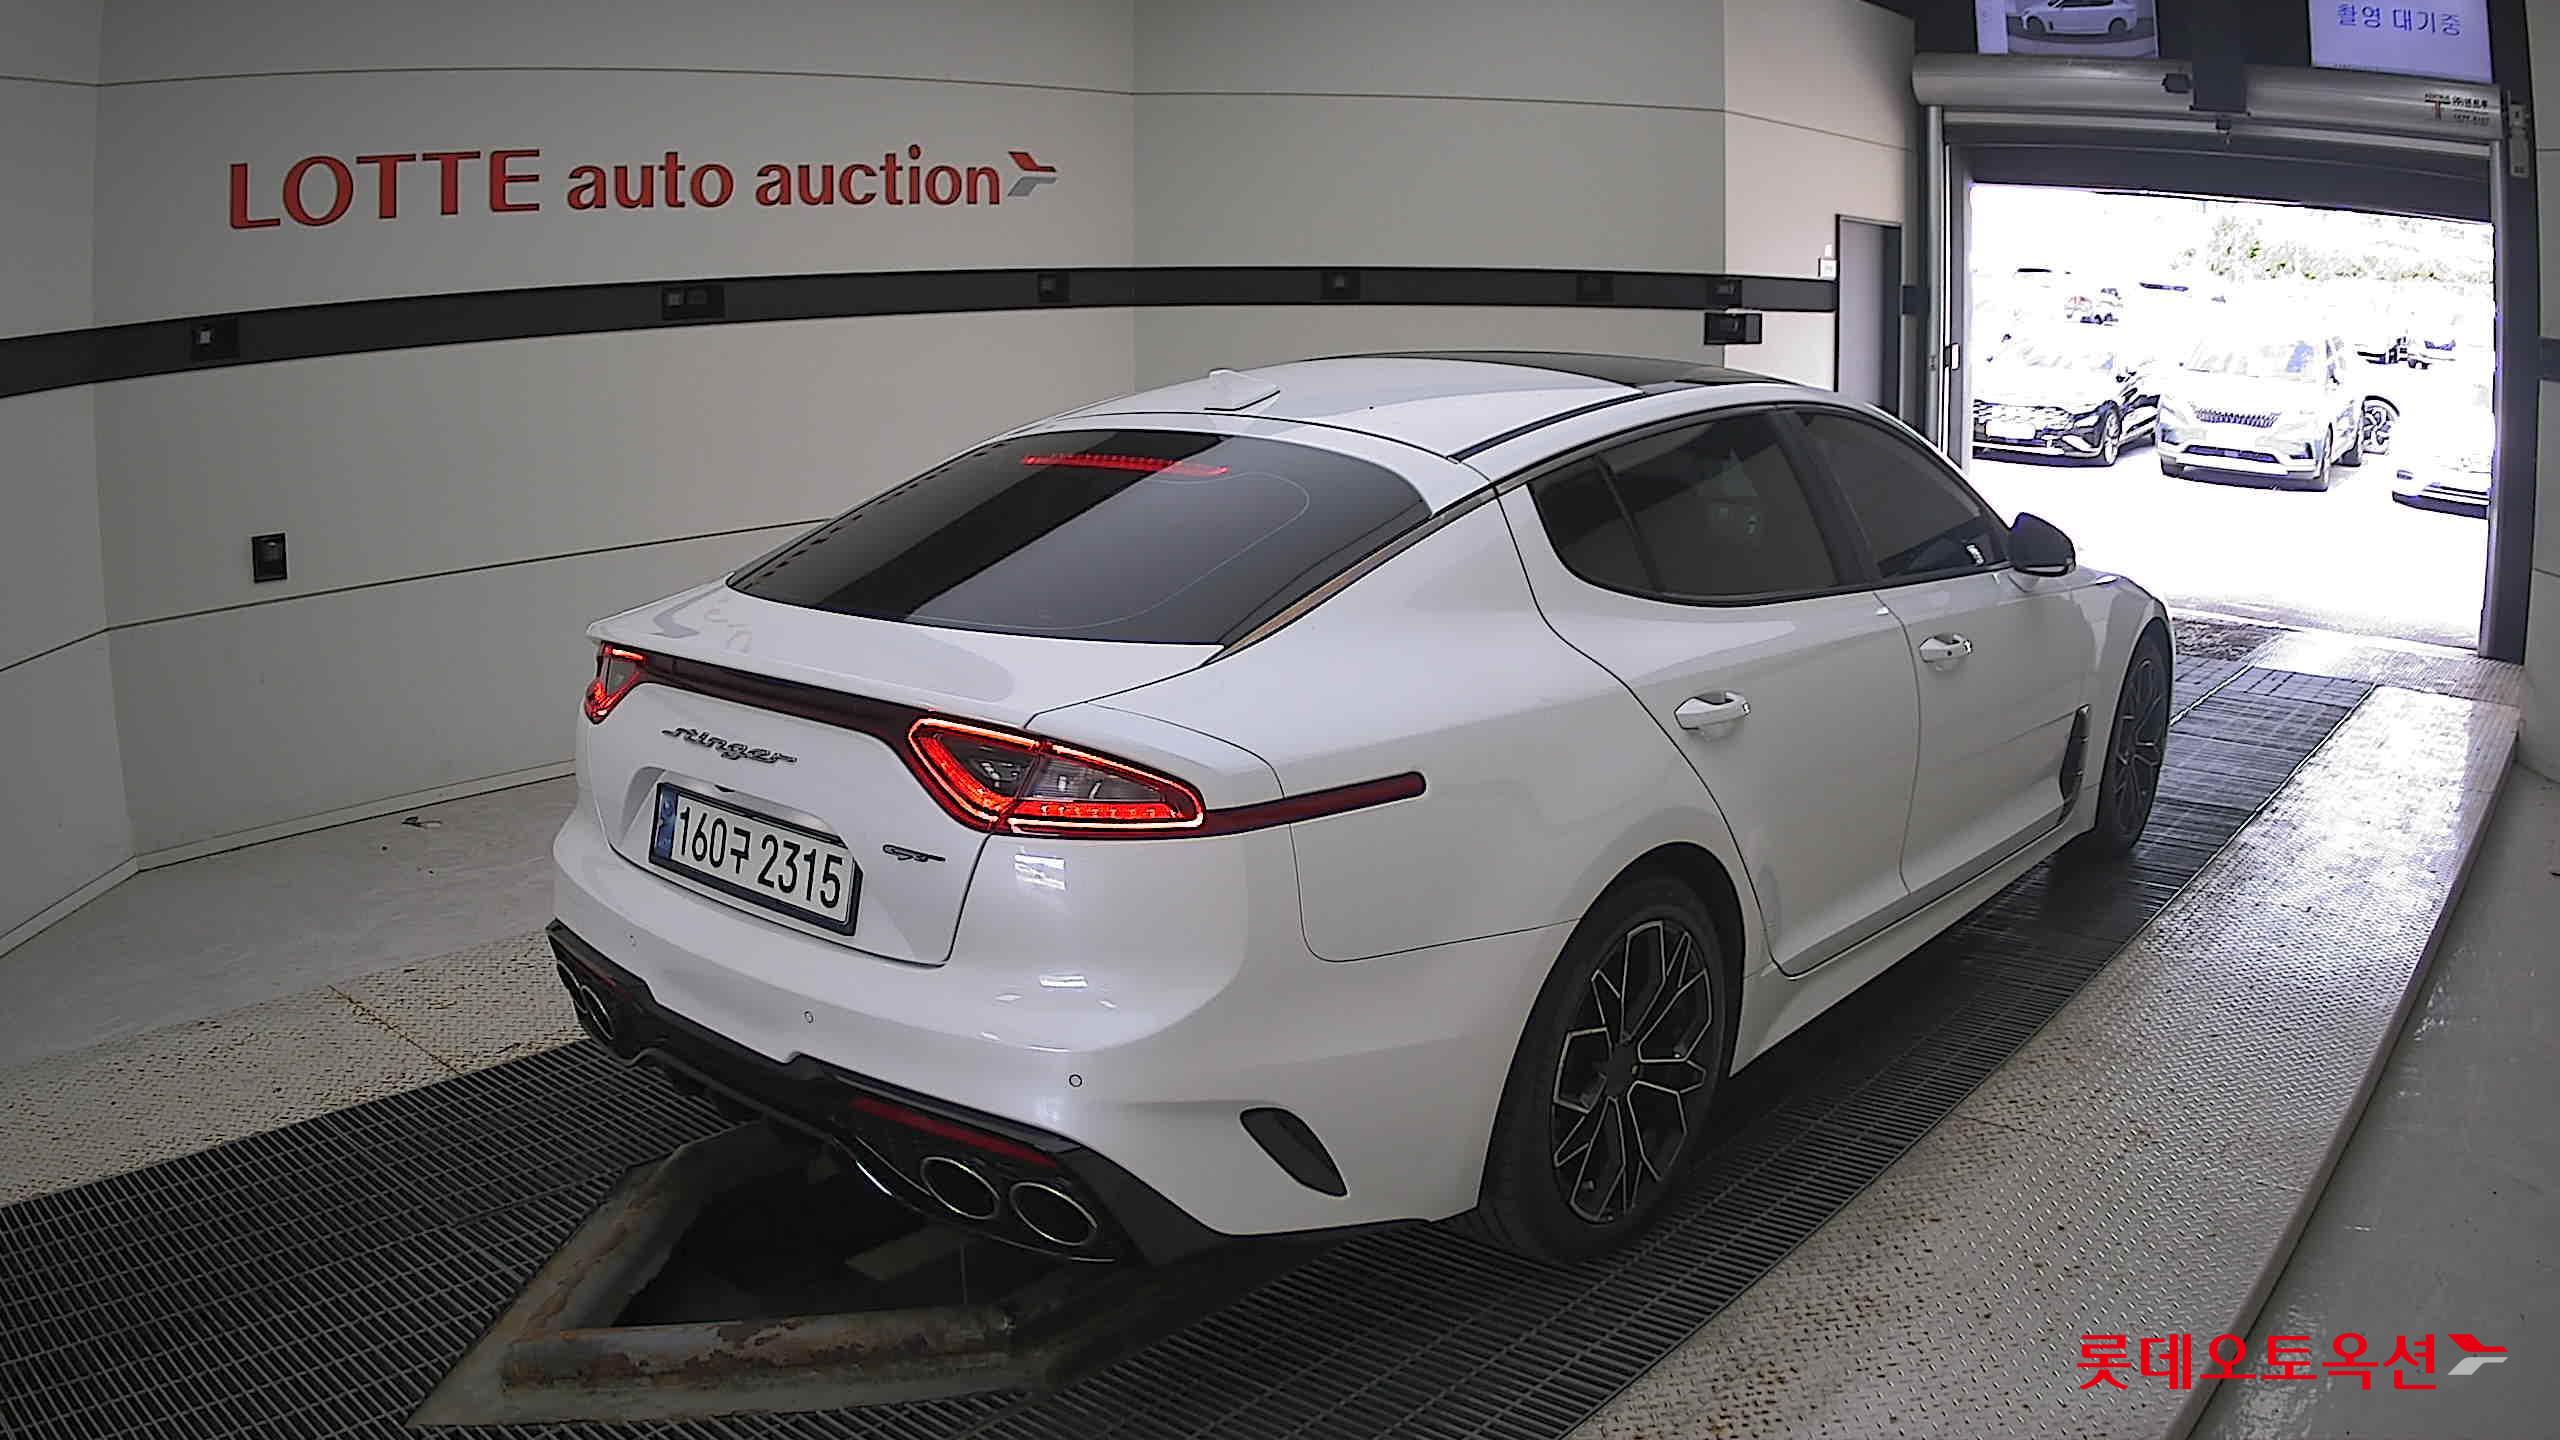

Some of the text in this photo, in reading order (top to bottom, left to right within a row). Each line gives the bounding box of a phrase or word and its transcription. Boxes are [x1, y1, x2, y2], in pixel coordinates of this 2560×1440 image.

[2338, 4, 2461, 36] 촬영 대기중
[230, 146, 1000, 229] LOTTE auto auction
